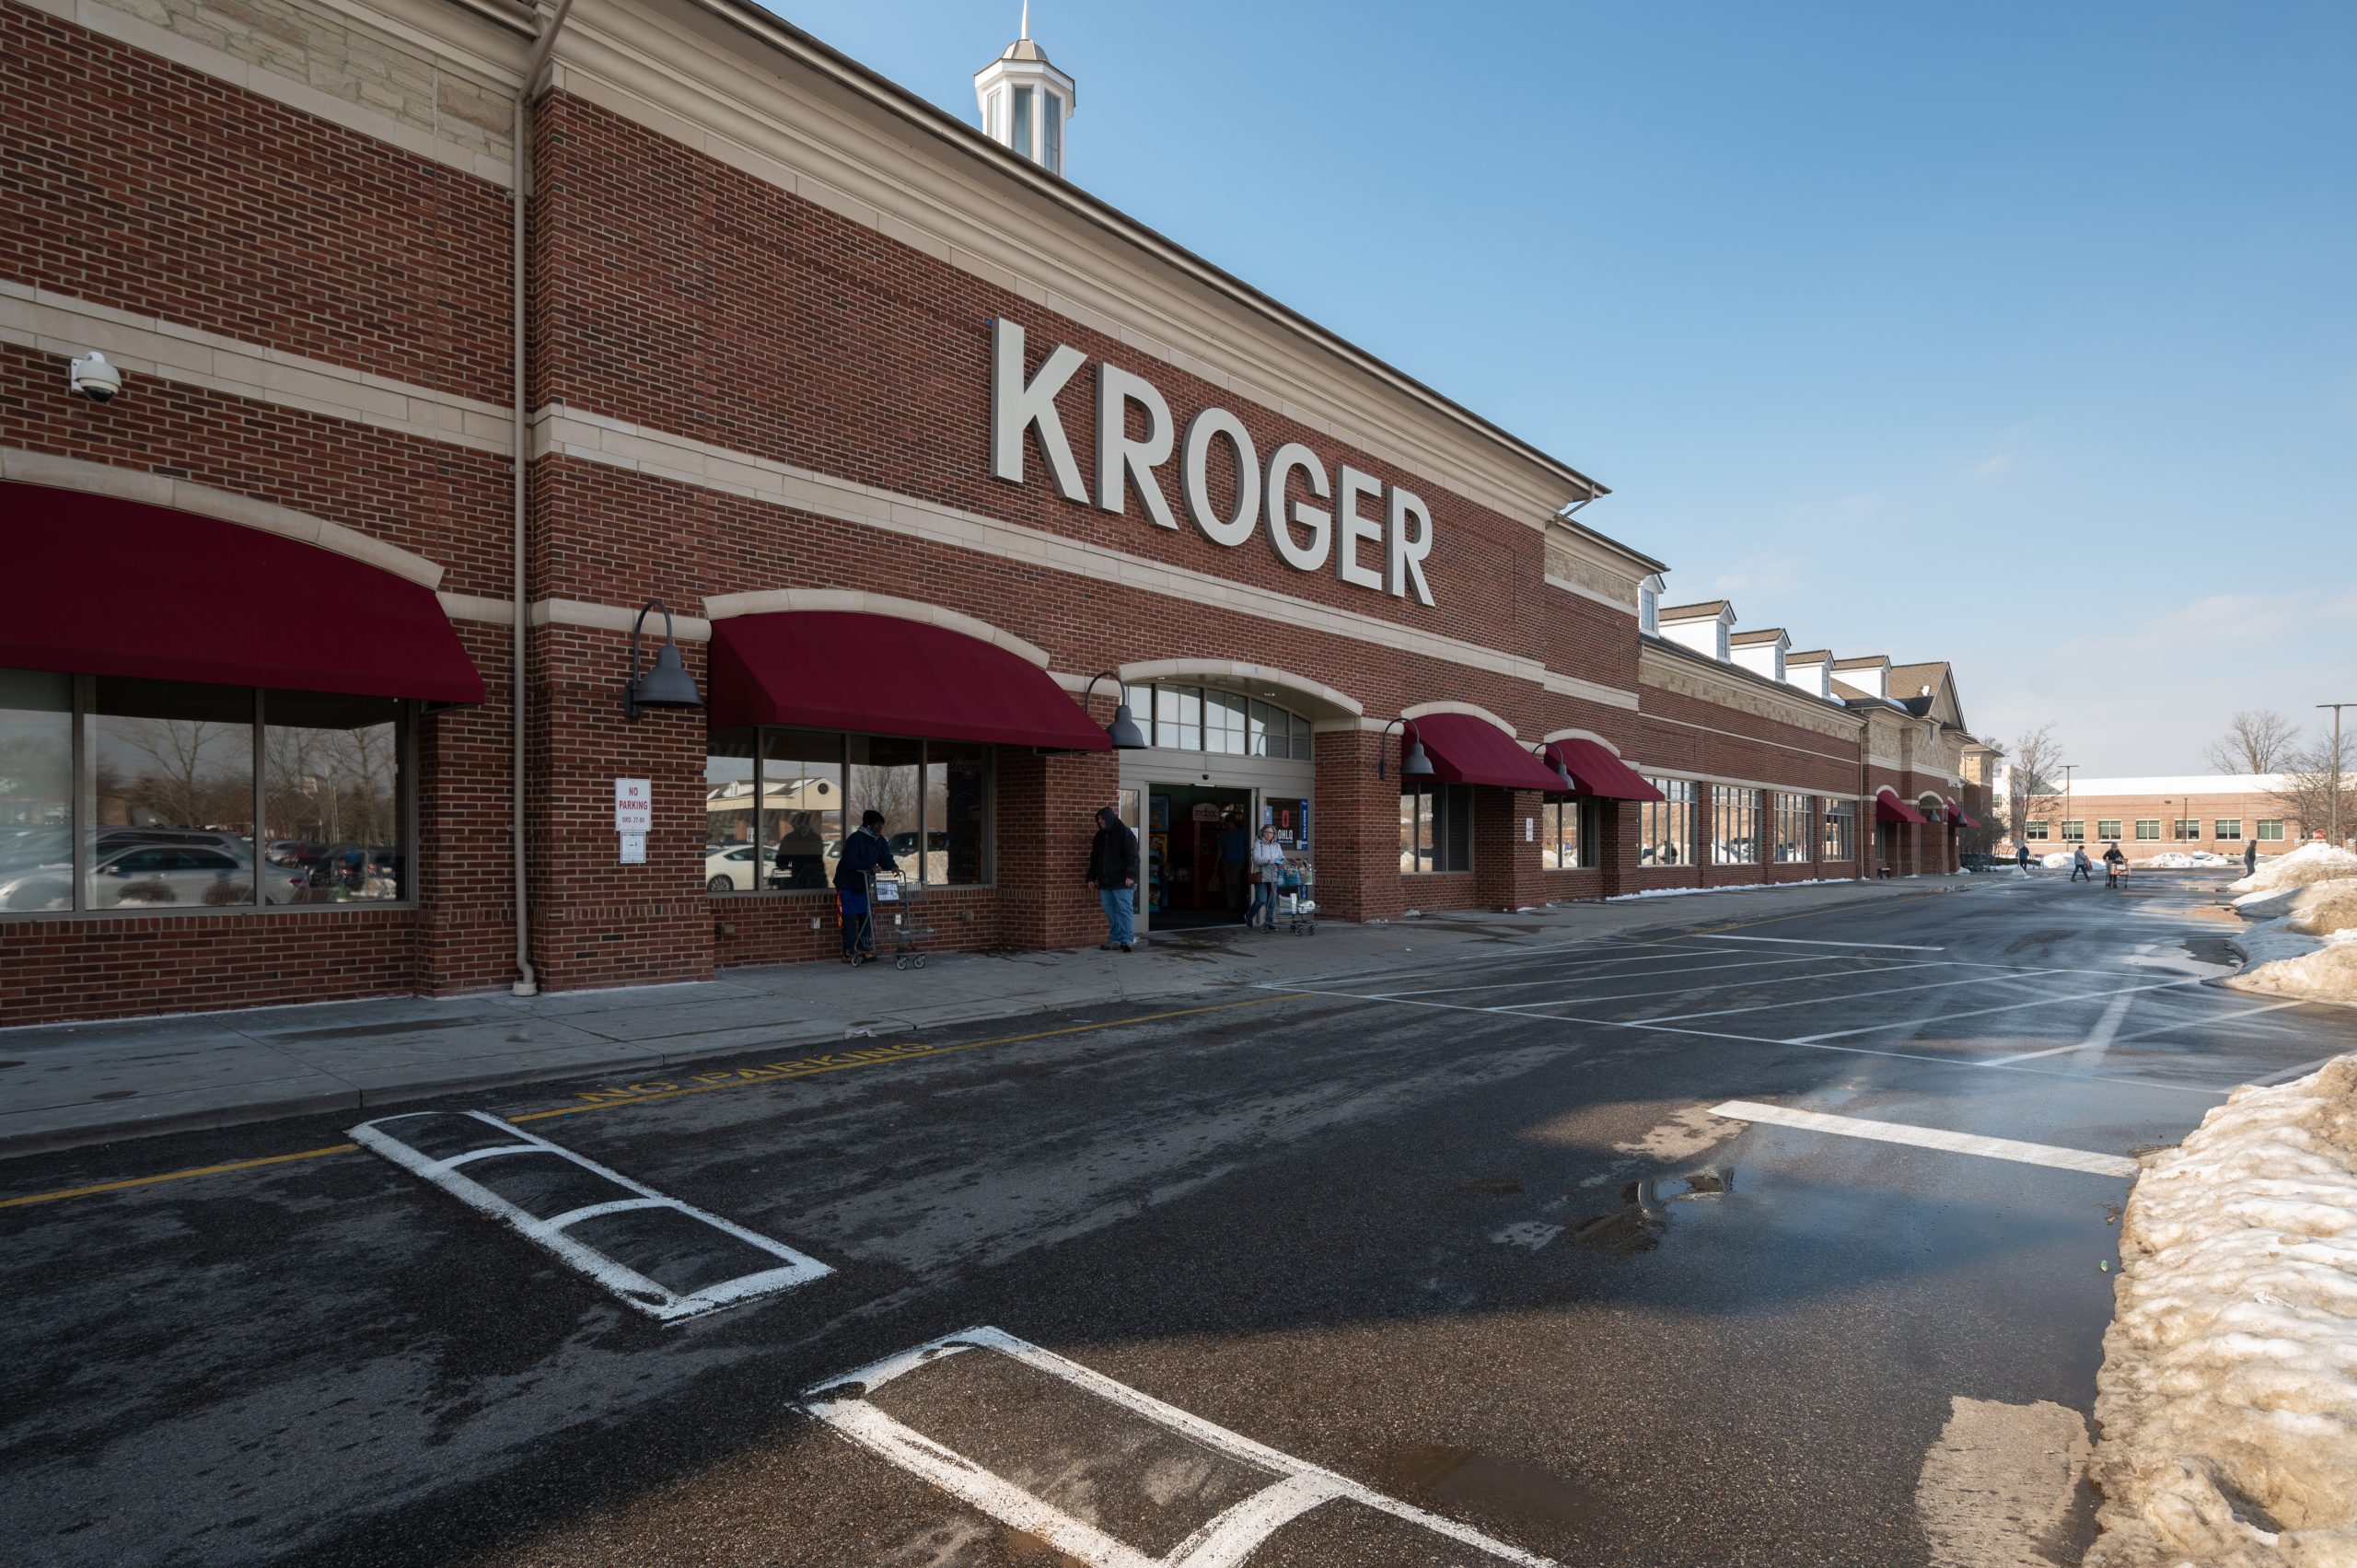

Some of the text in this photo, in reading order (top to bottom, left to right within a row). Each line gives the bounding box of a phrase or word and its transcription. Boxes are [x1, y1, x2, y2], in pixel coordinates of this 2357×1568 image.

[991, 316, 1435, 608] KROGER
[629, 786, 638, 796] NO
[619, 800, 648, 810] PARKING
[1277, 829, 1294, 841] OHLQ
[575, 1042, 934, 1103] NO PARKING
